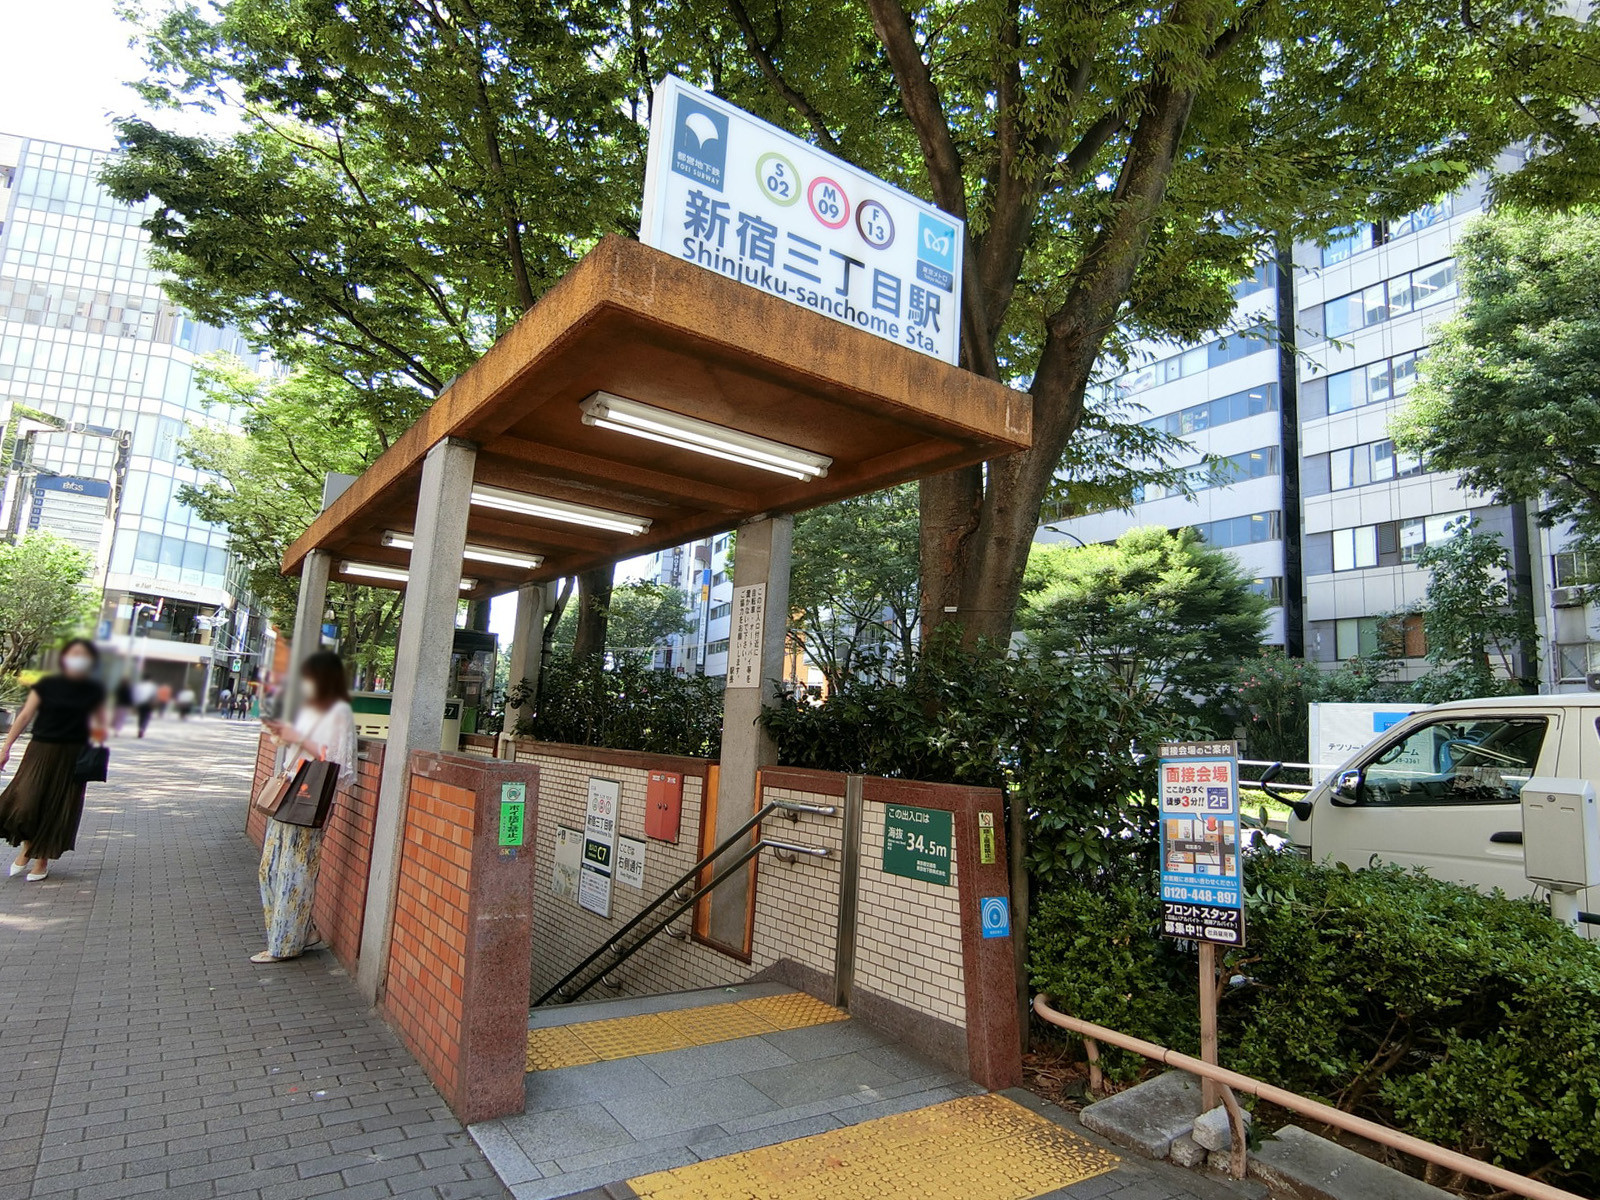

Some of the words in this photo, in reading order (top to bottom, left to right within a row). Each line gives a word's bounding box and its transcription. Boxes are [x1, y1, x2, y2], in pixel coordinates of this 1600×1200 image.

[677, 151, 721, 178] 都営地下鉄
[774, 162, 784, 176] S
[676, 161, 692, 174] TOEI
[693, 170, 720, 186] SUBWAY
[767, 175, 790, 198] 02
[822, 185, 836, 200] M
[818, 200, 839, 220] 09
[872, 208, 880, 221] F
[867, 220, 885, 242] 13
[683, 190, 941, 334] 新宿三丁目駅
[682, 237, 900, 338] Shinjuku-sanchome
[905, 326, 940, 355] Sta.
[1161, 744, 1231, 756] 面接会場のご案内
[1328, 742, 1365, 752] テツソー
[1166, 766, 1228, 783] 面接会場
[1166, 785, 1204, 794] ここからすぐ
[1210, 794, 1227, 807] 2F
[587, 814, 614, 833] 新宿三丁目駅
[888, 808, 930, 824] この出入口は
[887, 826, 904, 840] 海抜
[597, 846, 607, 861] C7
[906, 832, 947, 858] 34.5m
[618, 855, 643, 875] 右側通行
[1164, 886, 1237, 904] 0120-448-897
[1165, 904, 1238, 921] フロントスタッフ
[1165, 921, 1203, 936] 募集中!!
